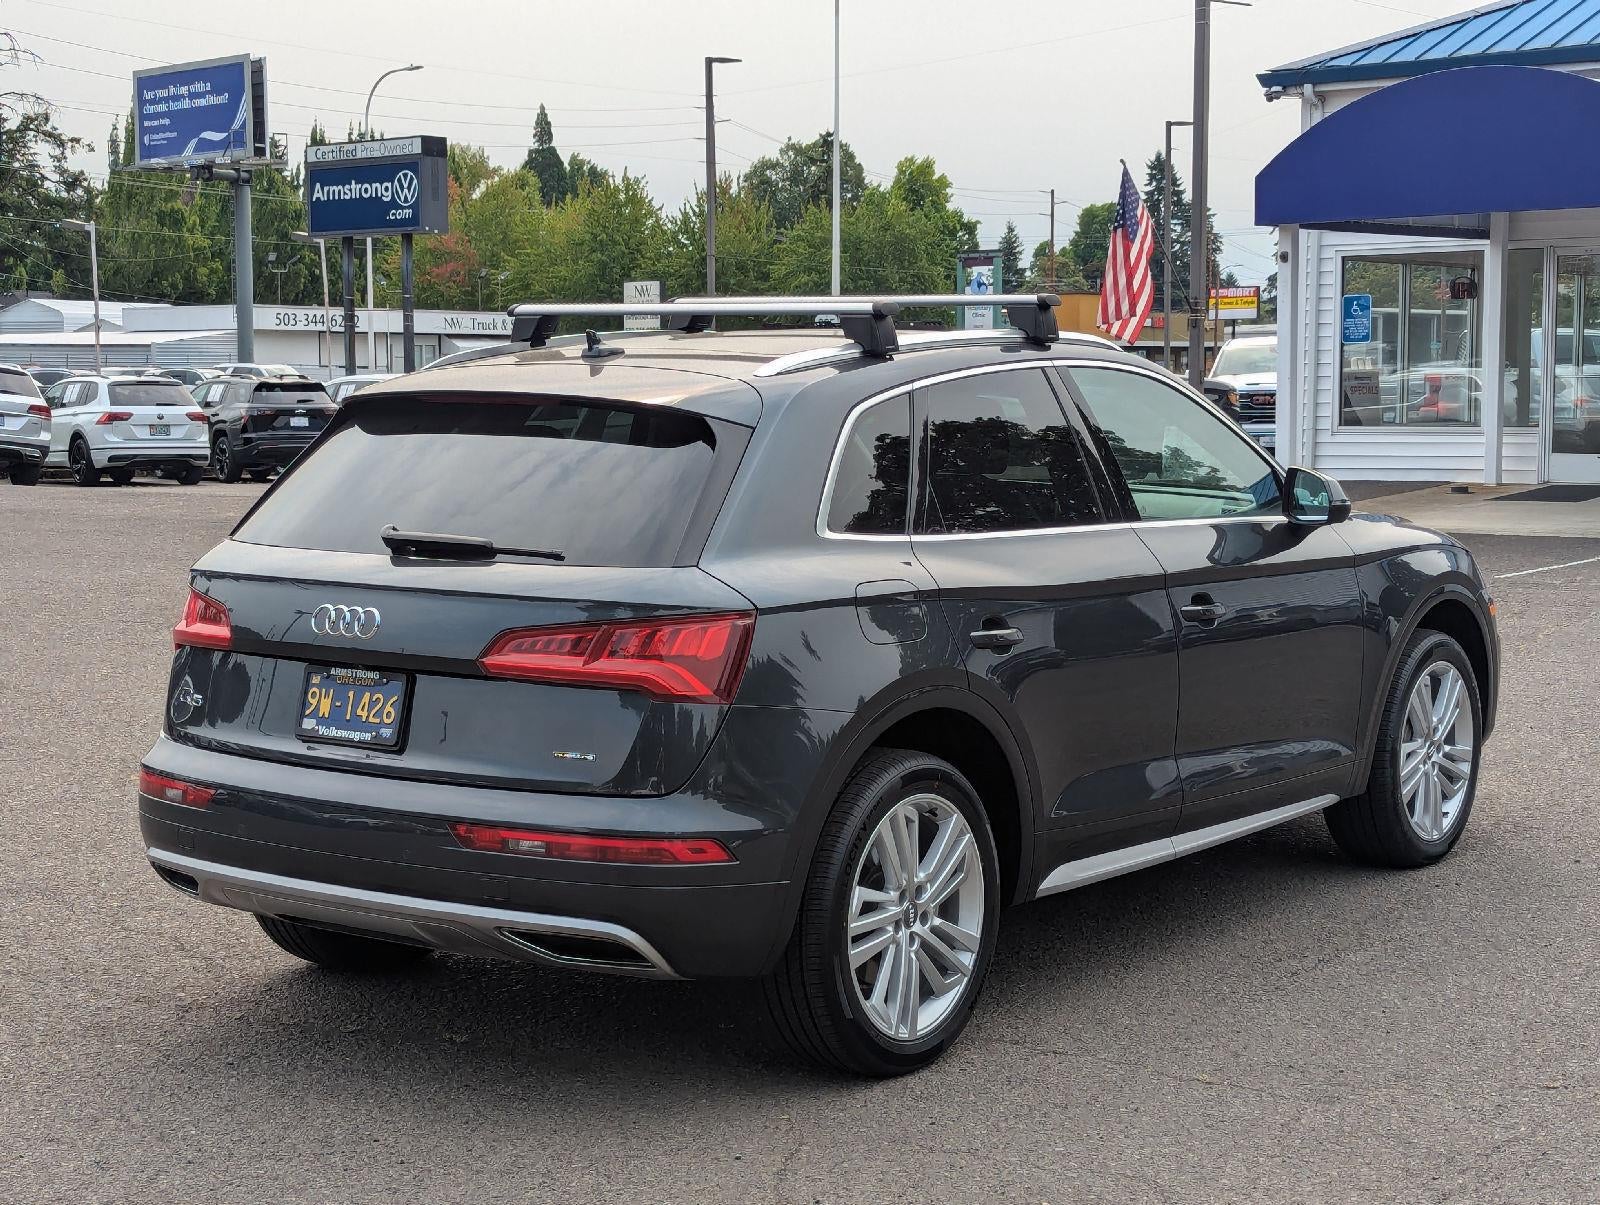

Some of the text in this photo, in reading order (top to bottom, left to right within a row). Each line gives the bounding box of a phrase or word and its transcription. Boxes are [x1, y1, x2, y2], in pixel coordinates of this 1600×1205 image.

[143, 81, 211, 100] Are you living with a
[143, 93, 229, 114] chronic health condition?
[314, 140, 414, 160] Certified Pre-Owned
[312, 179, 392, 202] Armstrong
[386, 208, 413, 220] .com
[633, 284, 653, 298] NW
[1227, 287, 1256, 298] MART
[443, 316, 464, 331] NW
[470, 317, 498, 331] Truck
[500, 319, 507, 331] &
[330, 667, 380, 680] ARMSTRONG
[336, 675, 375, 687] OREGON
[304, 686, 399, 725] 9W-1426
[318, 725, 372, 742] Volkswagen
